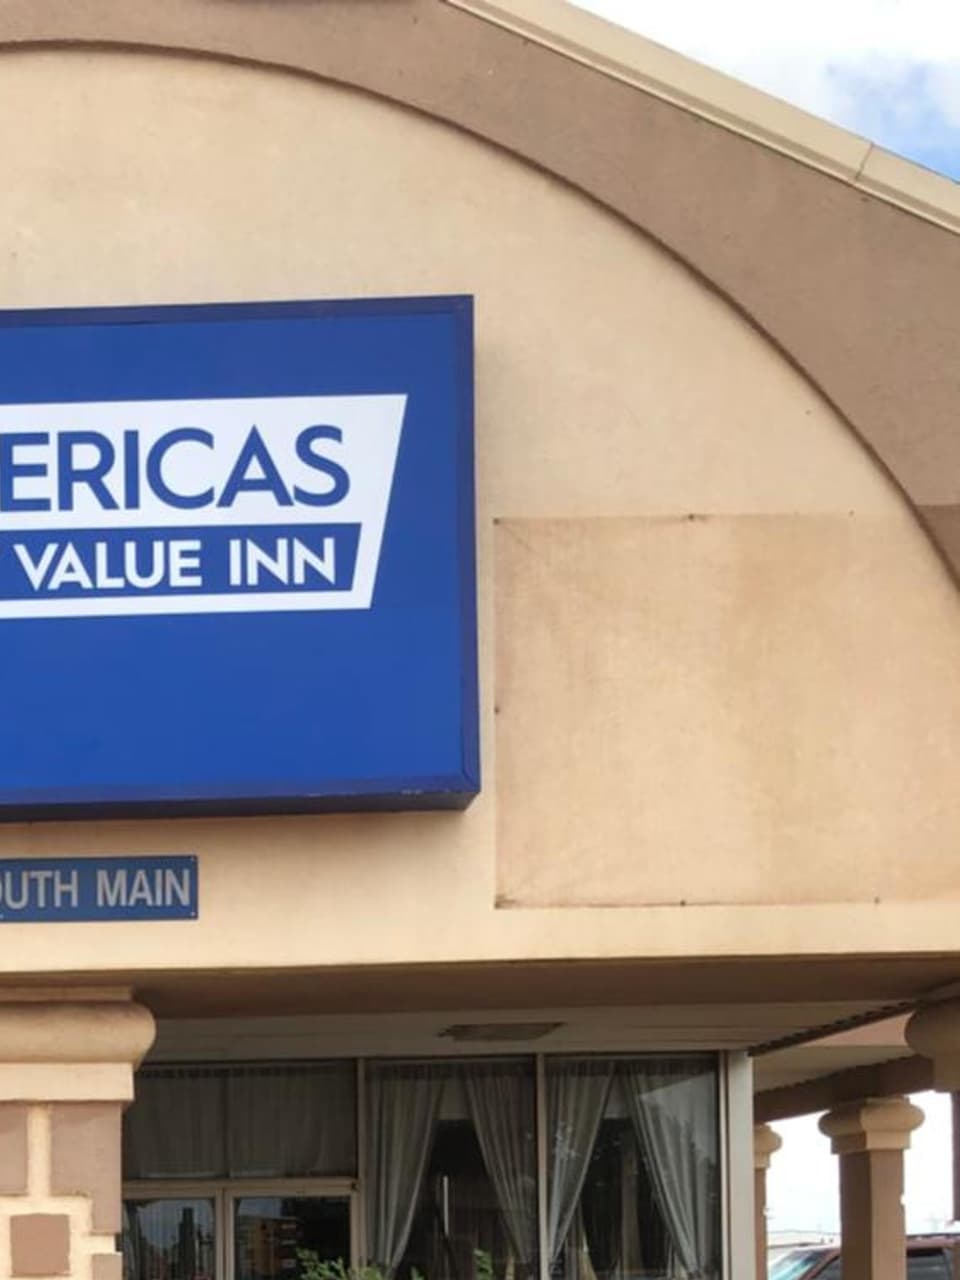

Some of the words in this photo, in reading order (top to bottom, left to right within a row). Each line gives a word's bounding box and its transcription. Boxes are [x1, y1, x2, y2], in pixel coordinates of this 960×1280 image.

[14, 540, 202, 590] VALUE
[229, 538, 336, 586] INN
[96, 869, 191, 908] MAIN
